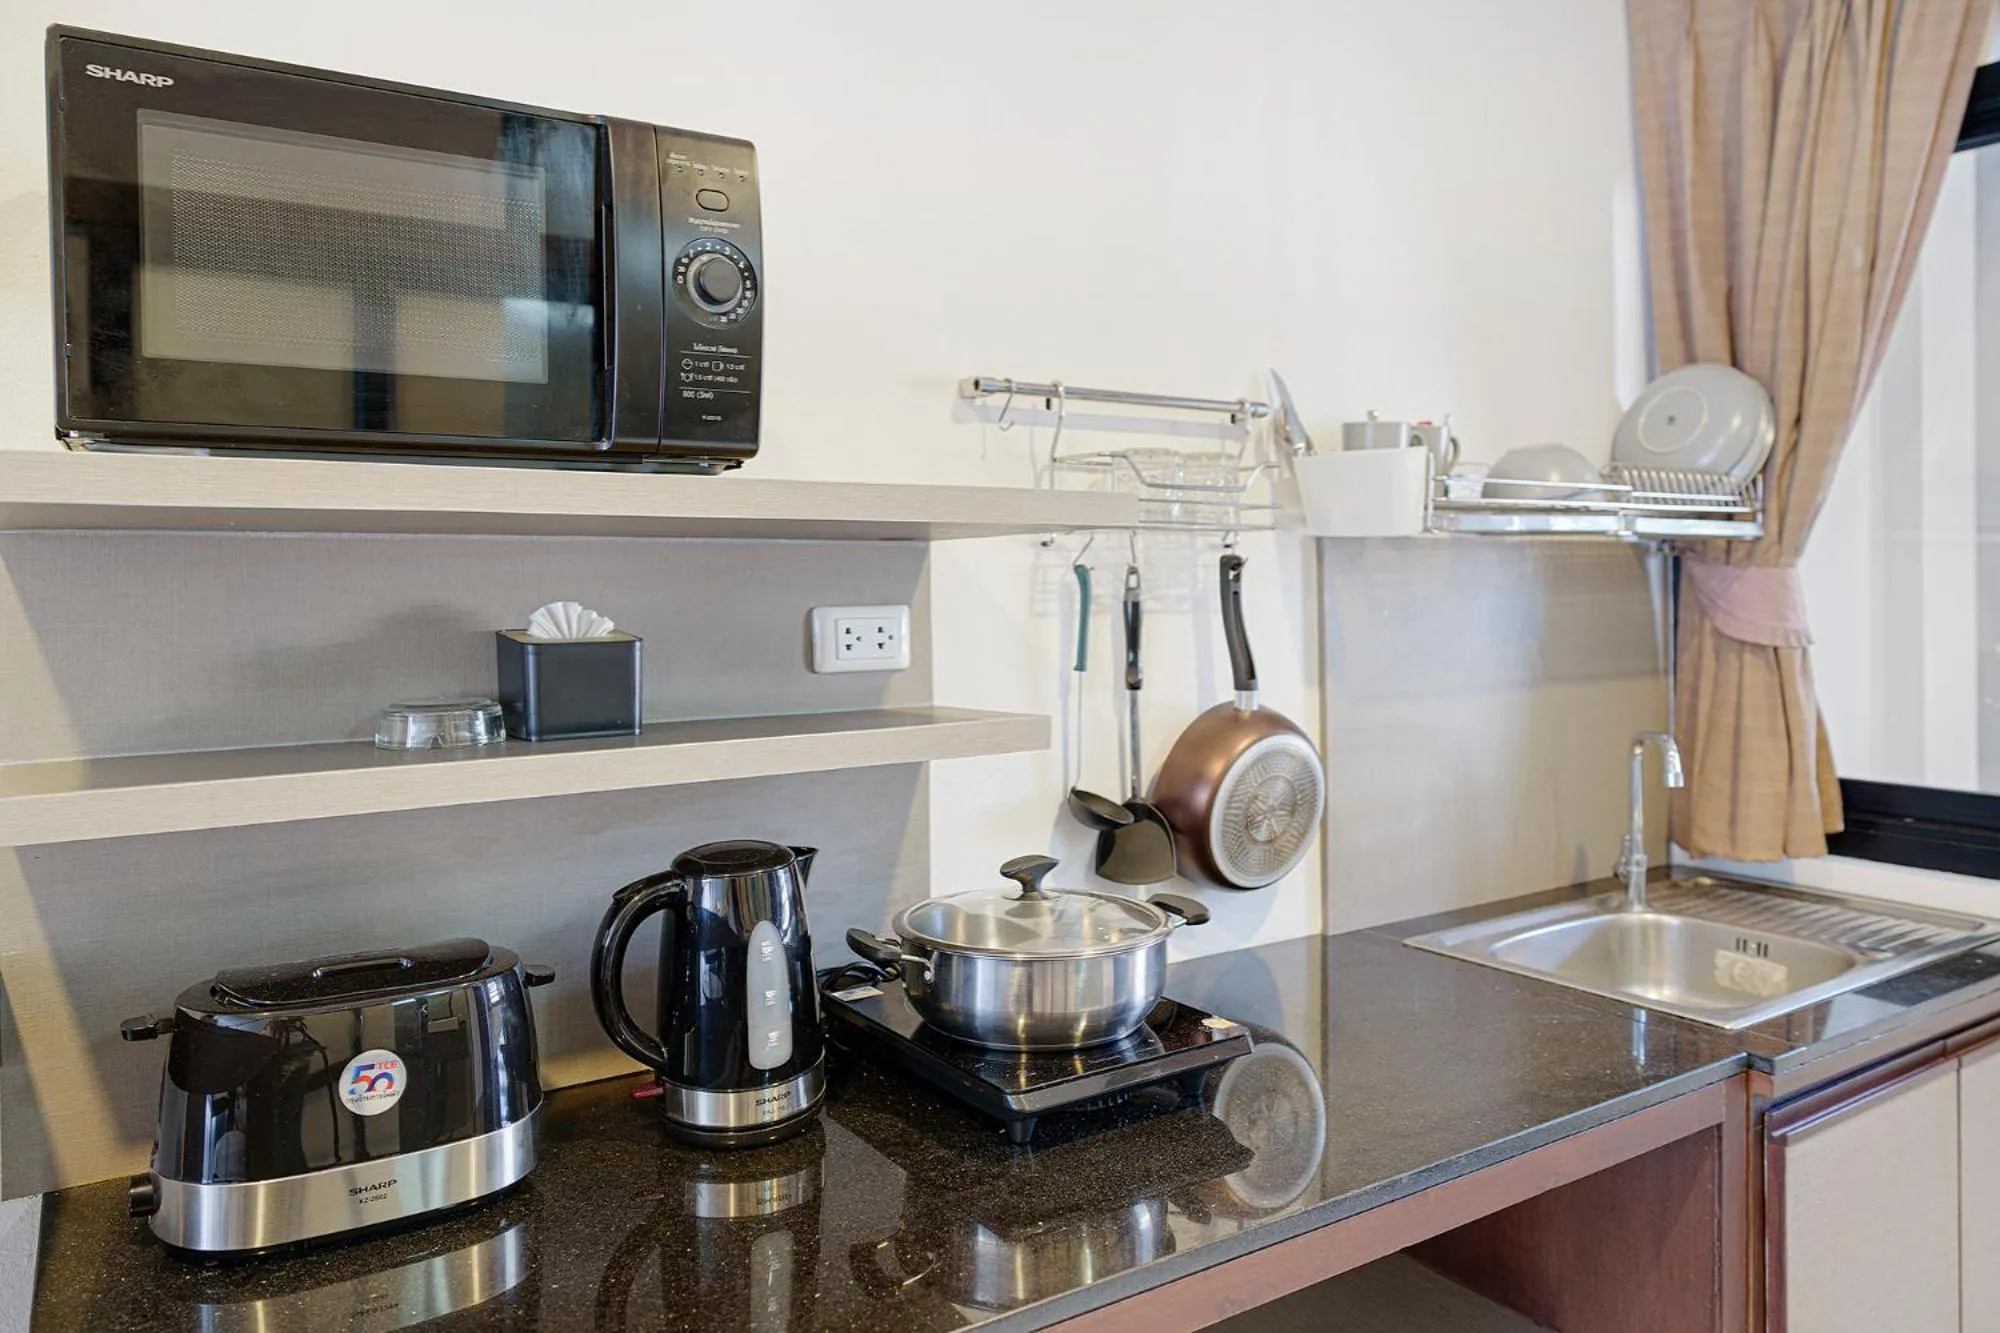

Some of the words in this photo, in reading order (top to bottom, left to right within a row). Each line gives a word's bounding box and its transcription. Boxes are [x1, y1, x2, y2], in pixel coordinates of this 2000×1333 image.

[85, 63, 175, 88] SHARP
[348, 1063, 395, 1097] 50
[755, 1091, 791, 1106] SHARP
[348, 1179, 397, 1197] SHARP
